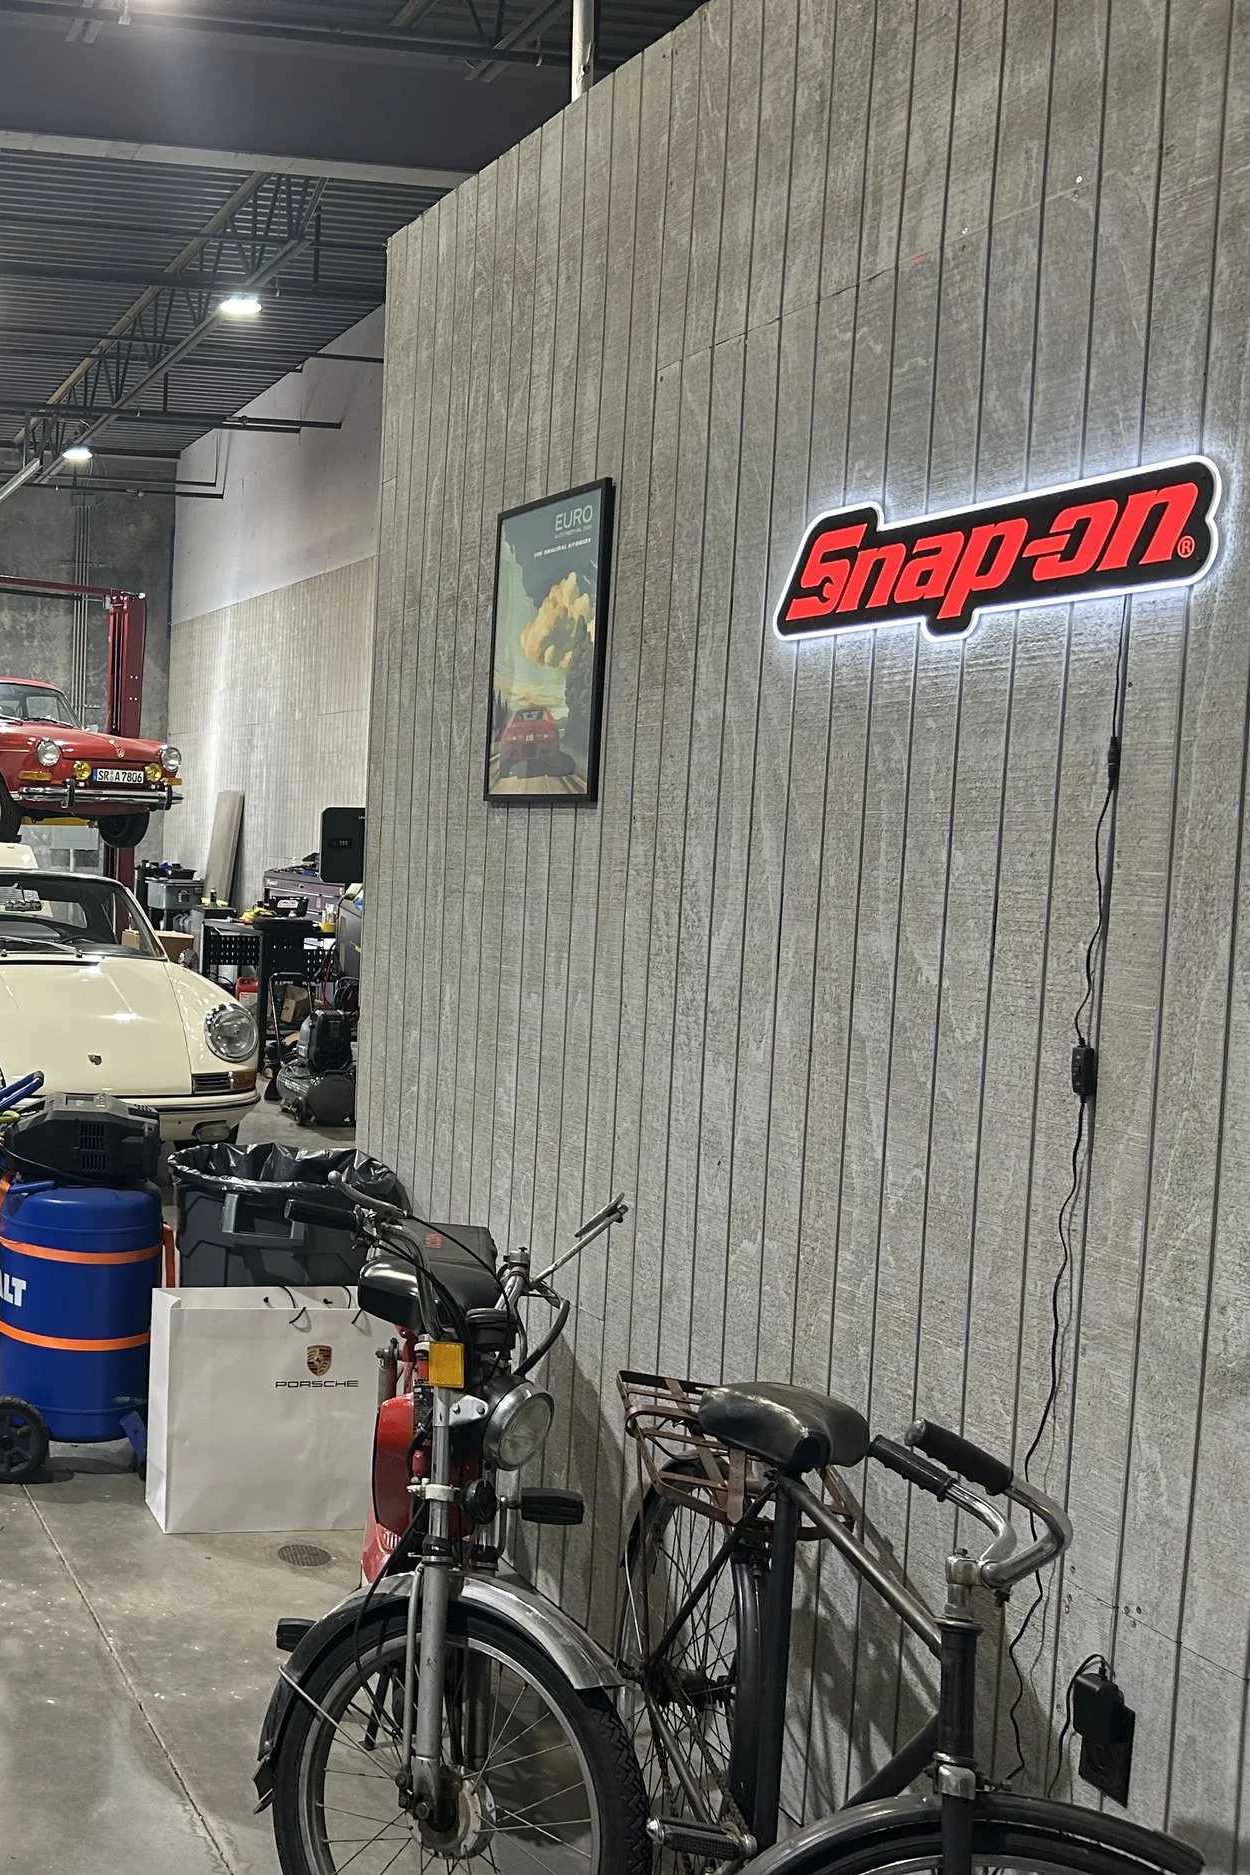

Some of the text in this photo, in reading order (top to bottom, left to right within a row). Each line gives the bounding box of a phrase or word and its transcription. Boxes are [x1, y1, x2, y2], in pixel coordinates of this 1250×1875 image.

[555, 505, 593, 531] EURO
[98, 770, 109, 781] SR
[275, 1380, 359, 1388] PORSCHE
